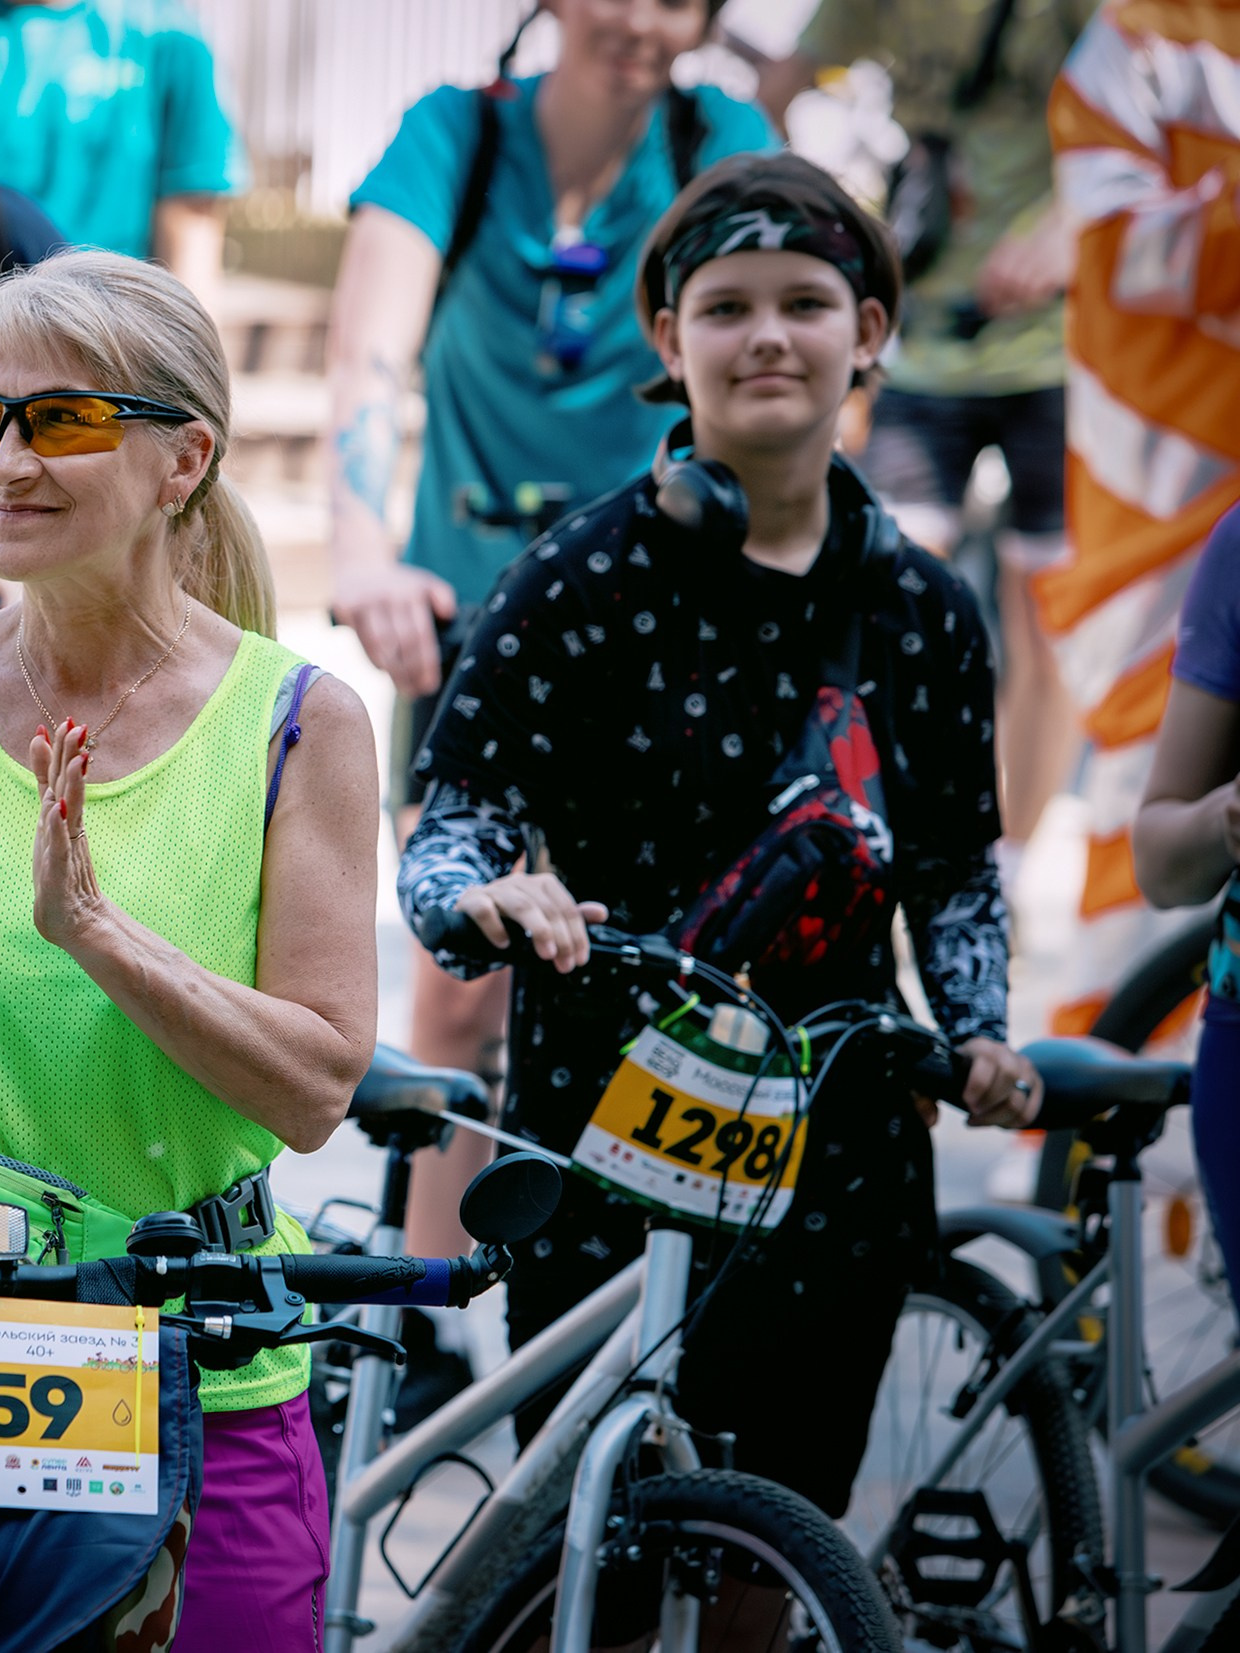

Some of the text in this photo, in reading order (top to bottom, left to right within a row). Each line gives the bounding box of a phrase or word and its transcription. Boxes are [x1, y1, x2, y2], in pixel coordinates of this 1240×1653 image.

[631, 1088, 781, 1179] 1298
[60, 1333, 106, 1347] заезд
[110, 1336, 127, 1347] №
[26, 1345, 54, 1358] 40+
